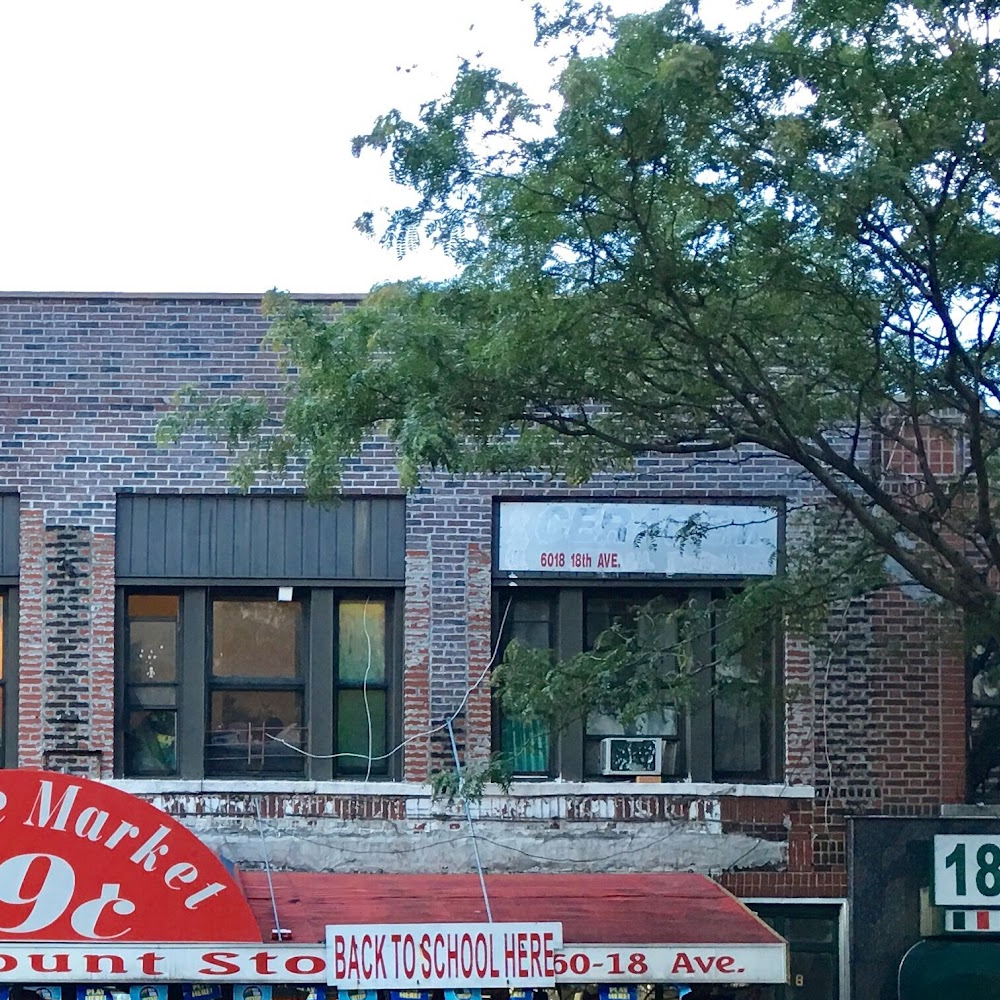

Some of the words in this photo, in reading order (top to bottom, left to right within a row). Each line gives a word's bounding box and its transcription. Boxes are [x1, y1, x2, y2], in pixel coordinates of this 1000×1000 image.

[540, 552, 566, 568] 6018
[570, 552, 592, 568] 18th
[597, 552, 621, 568] AVE.
[23, 779, 227, 911] Market
[334, 934, 388, 980] BACK
[391, 934, 416, 979] TO
[420, 933, 500, 979] SCHOOL
[504, 932, 555, 978] HERE
[553, 952, 648, 975] 60-18
[670, 952, 746, 974] Ave.
[86, 988, 105, 996] PLAY
